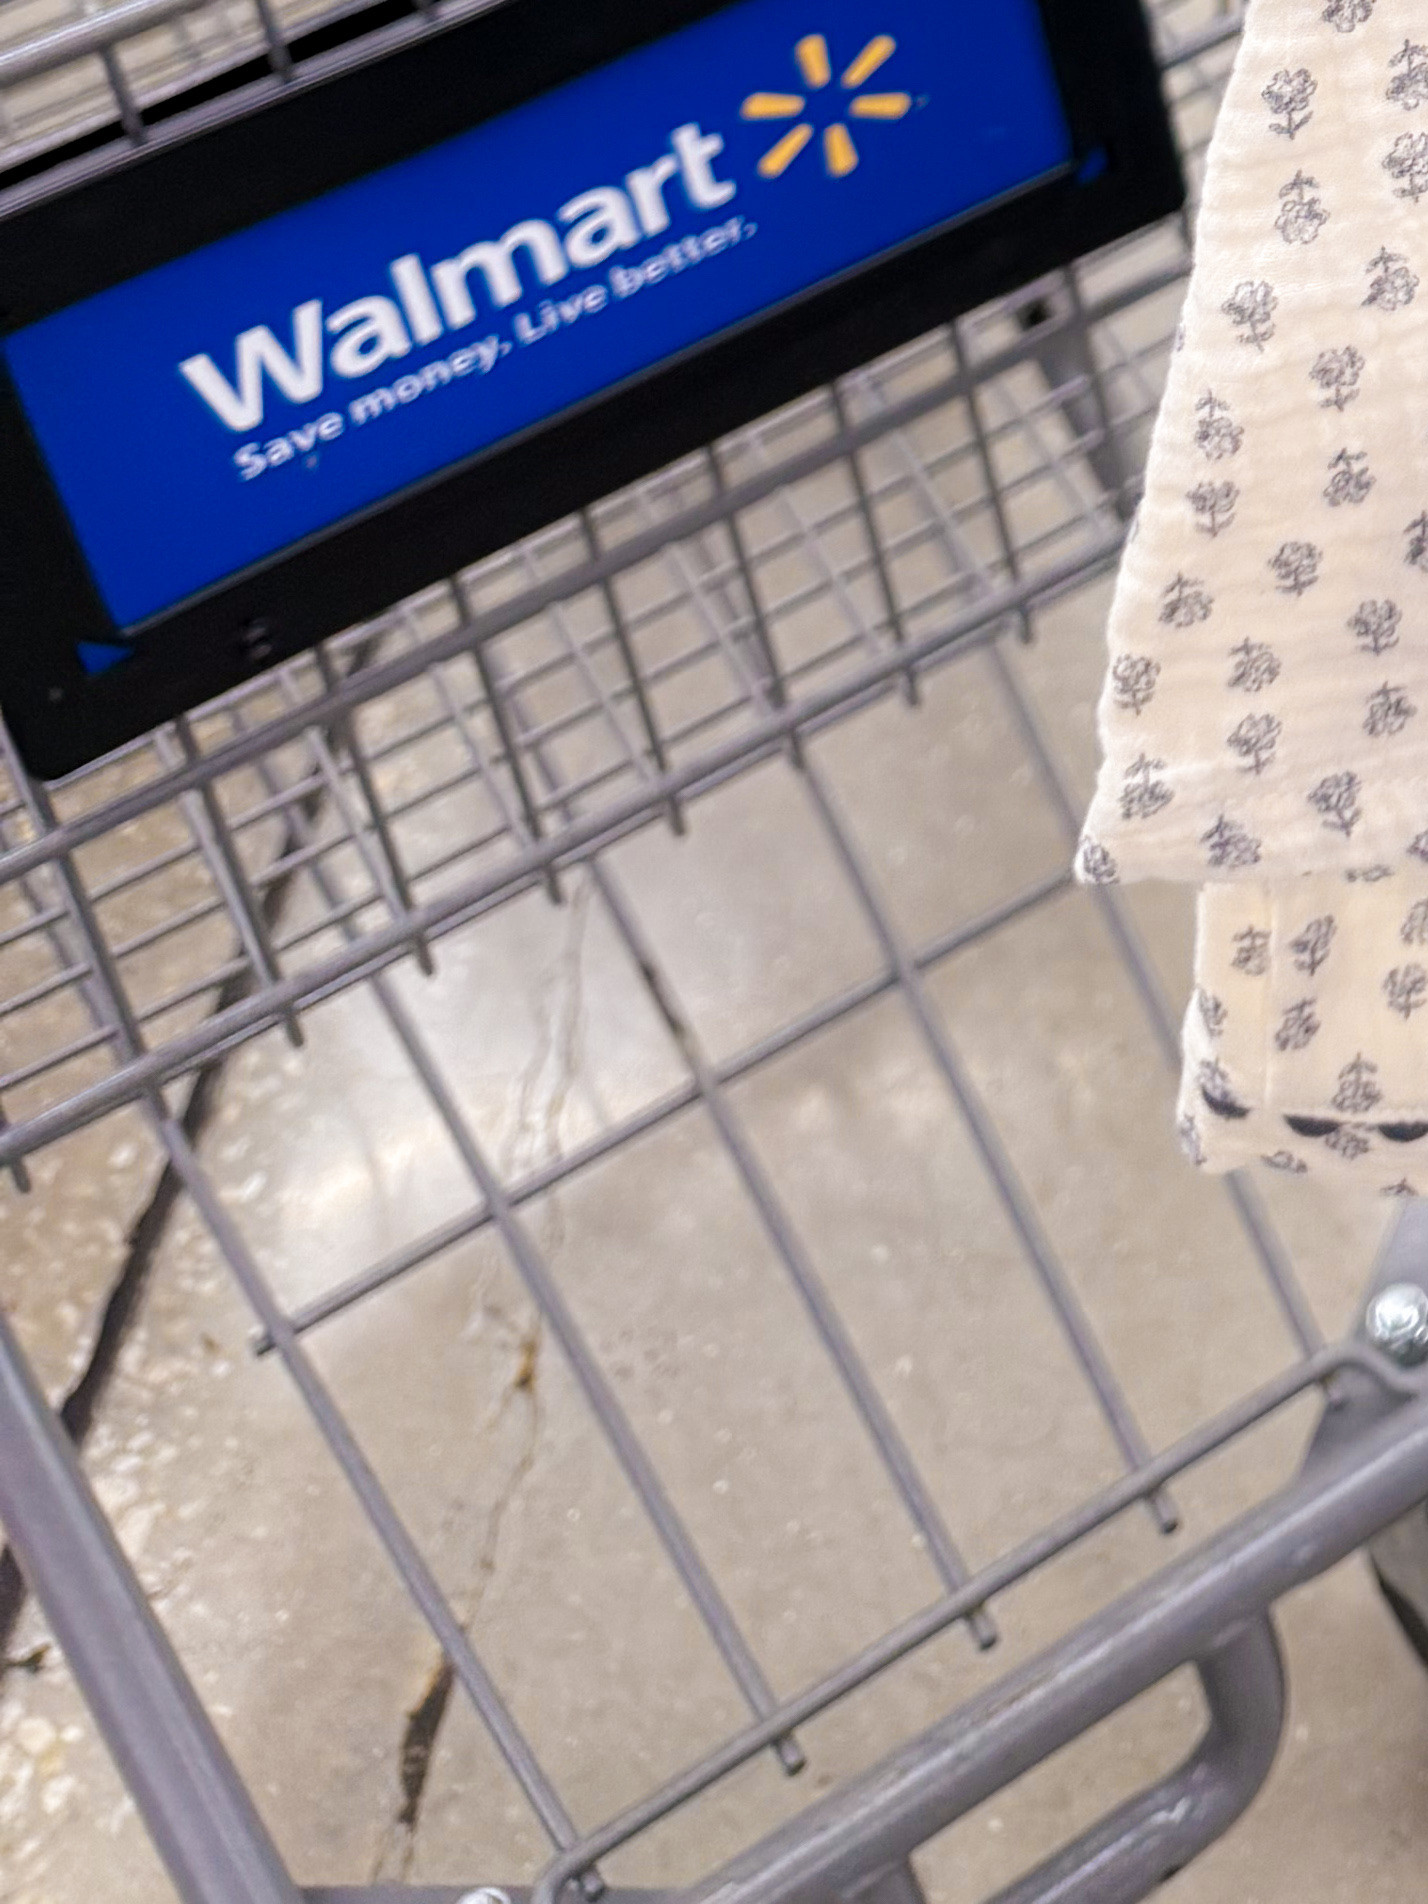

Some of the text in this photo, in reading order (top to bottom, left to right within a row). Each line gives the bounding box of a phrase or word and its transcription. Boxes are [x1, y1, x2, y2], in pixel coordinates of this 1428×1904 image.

[178, 120, 738, 434] Walmart
[231, 214, 759, 482] Save money. Live better.
